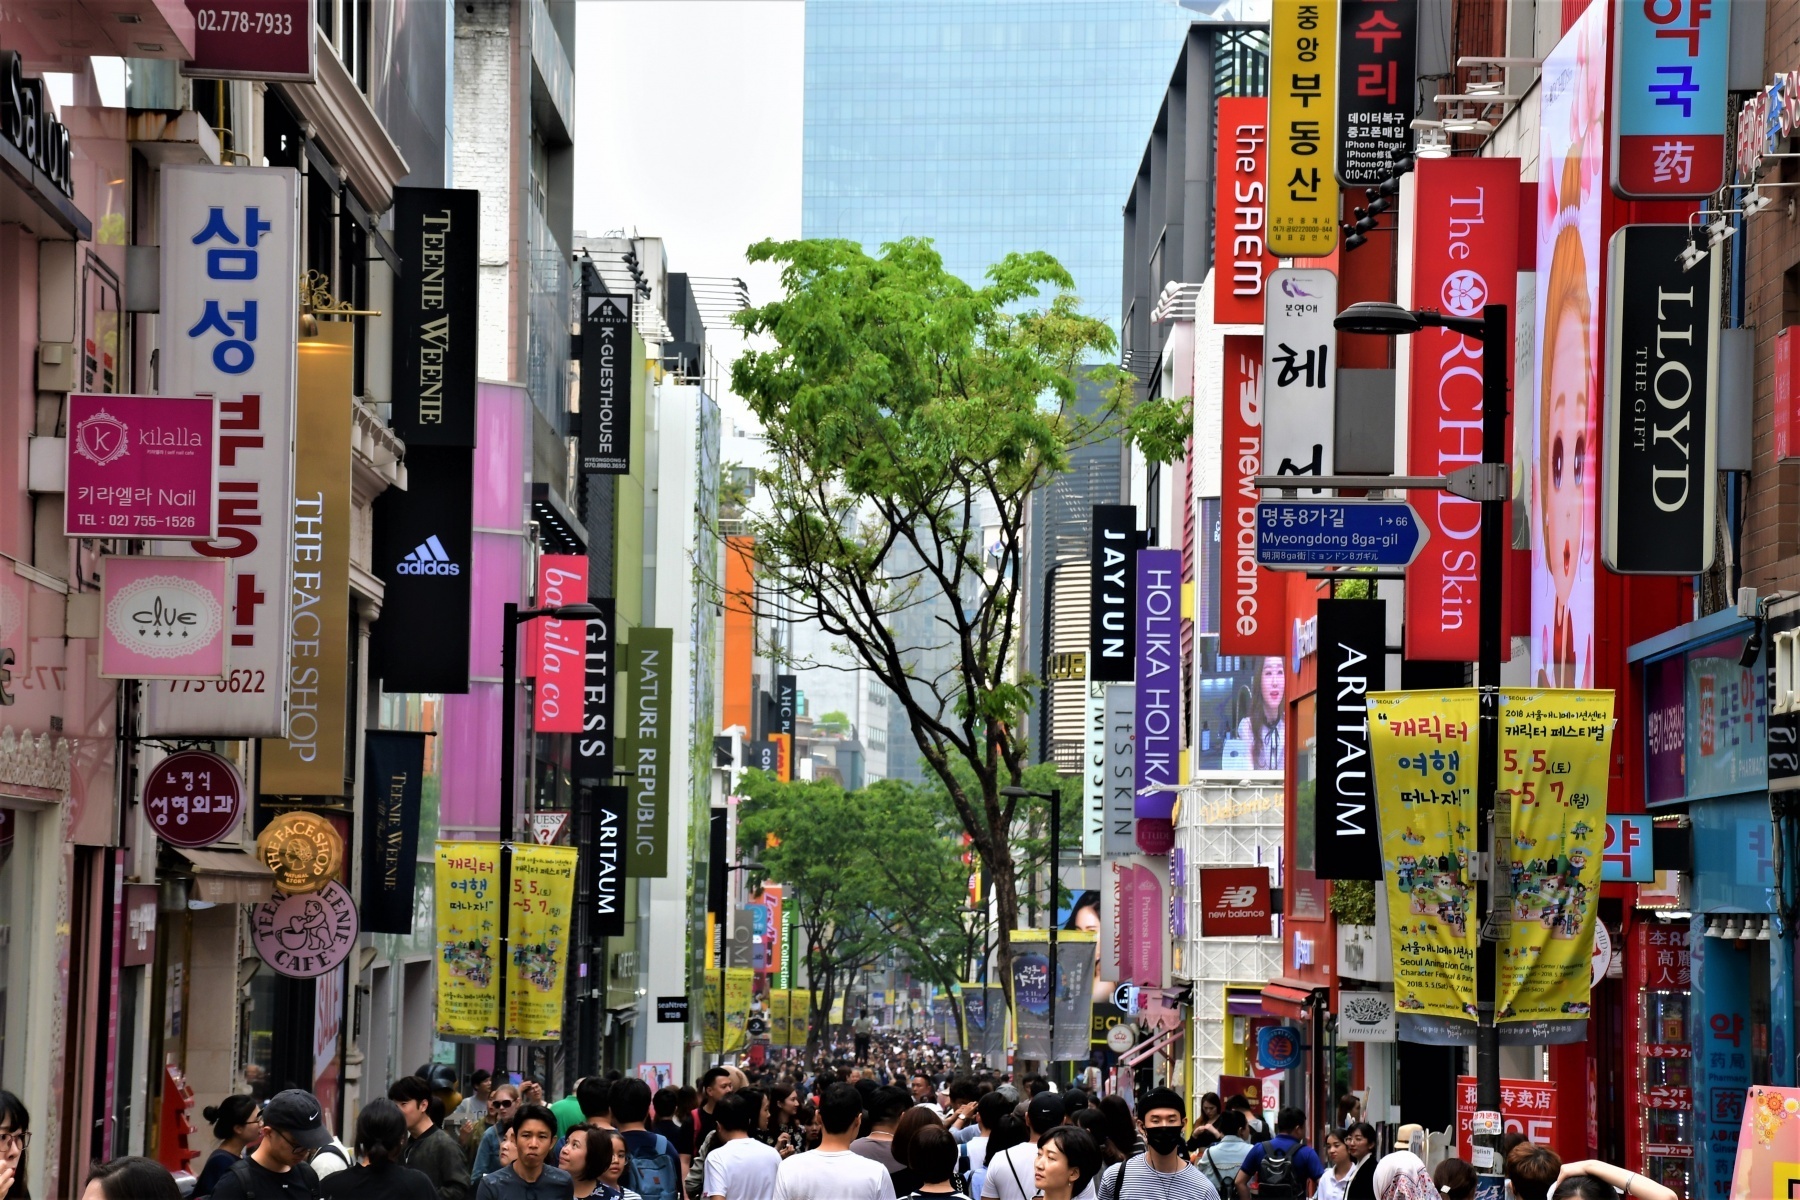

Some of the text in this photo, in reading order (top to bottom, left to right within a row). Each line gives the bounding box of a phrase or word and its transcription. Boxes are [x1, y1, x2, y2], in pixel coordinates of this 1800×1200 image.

[198, 9, 293, 36] 02.778-7933
[10, 50, 73, 199] Salon
[1235, 124, 1265, 173] the
[1377, 141, 1406, 149] Repair
[1652, 141, 1695, 184] 药
[1449, 186, 1485, 260] The
[188, 206, 272, 375] 삼성
[418, 209, 451, 425] TEENIE WEENIE
[598, 326, 614, 454] K-GUESTHOUSE
[1633, 346, 1648, 452] THE GIFT
[1652, 285, 1695, 512] LLOYD
[139, 427, 203, 447] kilalla
[78, 485, 196, 507] 키라엘라 Nail
[78, 513, 97, 526] TEL
[134, 515, 196, 528] 755-1526
[1262, 507, 1345, 528] 명동8가길
[1395, 516, 1408, 526] 66
[1235, 436, 1259, 637] new balance
[1262, 532, 1398, 547] Myeongdong 8ga-gil
[396, 560, 460, 577] adidas
[1441, 550, 1478, 633] Skin
[288, 491, 323, 763] THE FACE SHOP
[580, 616, 607, 757] GUESS
[780, 684, 792, 718] AHC
[1144, 569, 1172, 799] HOLIKA HOLIKA
[1335, 642, 1368, 836] ARITAUM
[1505, 723, 1605, 741] 캐릭터 페스티벌
[635, 649, 660, 856] NATURE REPUBLIC
[1398, 749, 1460, 785] 여행
[1503, 749, 1523, 774] 5.
[166, 771, 211, 792] 노정식
[150, 795, 234, 826] 성형외과
[268, 822, 330, 876] THE FACE SHOP
[597, 808, 618, 914] ARITAUM
[450, 878, 488, 899] 여행
[1208, 909, 1265, 919] new balance
[780, 911, 790, 990] Nature Collection
[1142, 896, 1151, 971] Princess House
[274, 949, 331, 972] CAFE
[1400, 958, 1423, 967] Seoul
[1400, 969, 1434, 978] Character
[1348, 1026, 1388, 1036] innisfree
[1708, 1073, 1748, 1083] Pharmacy
[1465, 1087, 1552, 1109] 批专卖店
